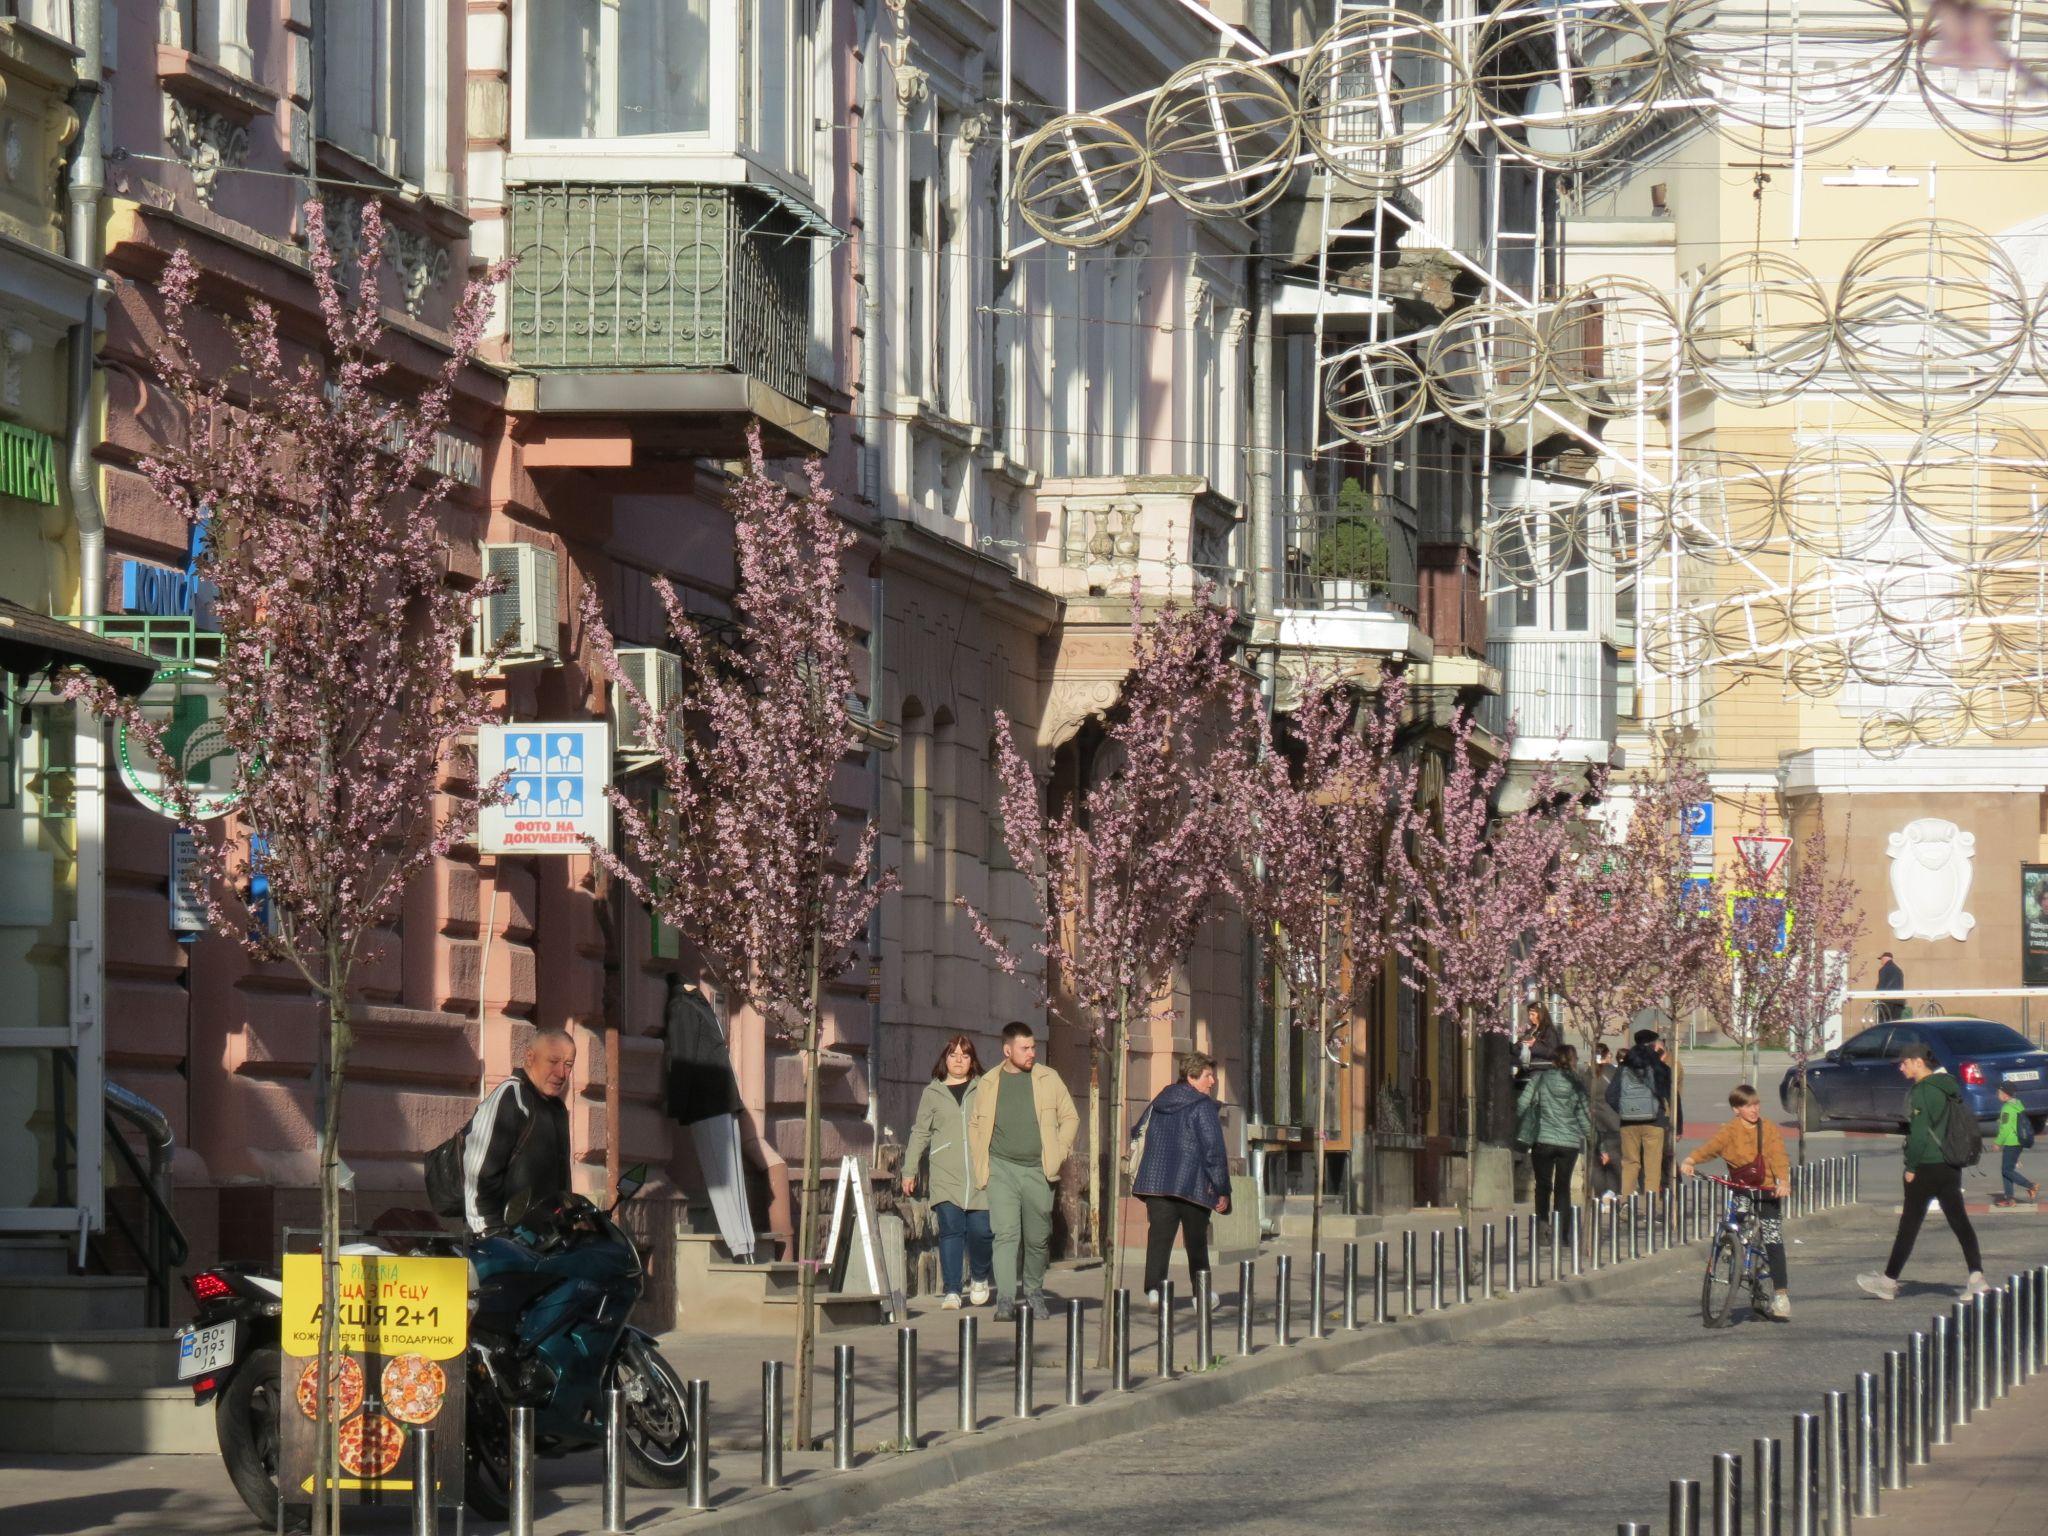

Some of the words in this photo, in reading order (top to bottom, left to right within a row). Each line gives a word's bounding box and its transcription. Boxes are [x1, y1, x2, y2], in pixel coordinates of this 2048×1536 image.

[0, 420, 59, 506] ПТЕКА
[515, 821, 551, 832] ФОТО
[556, 821, 575, 832] НА
[395, 1305, 439, 1327] 2+1
[293, 1332, 321, 1341] КОЖН
[392, 1335, 454, 1345] ПОДАРУНОК
[194, 1340, 225, 1358] 0193
[201, 1356, 216, 1370] JA
